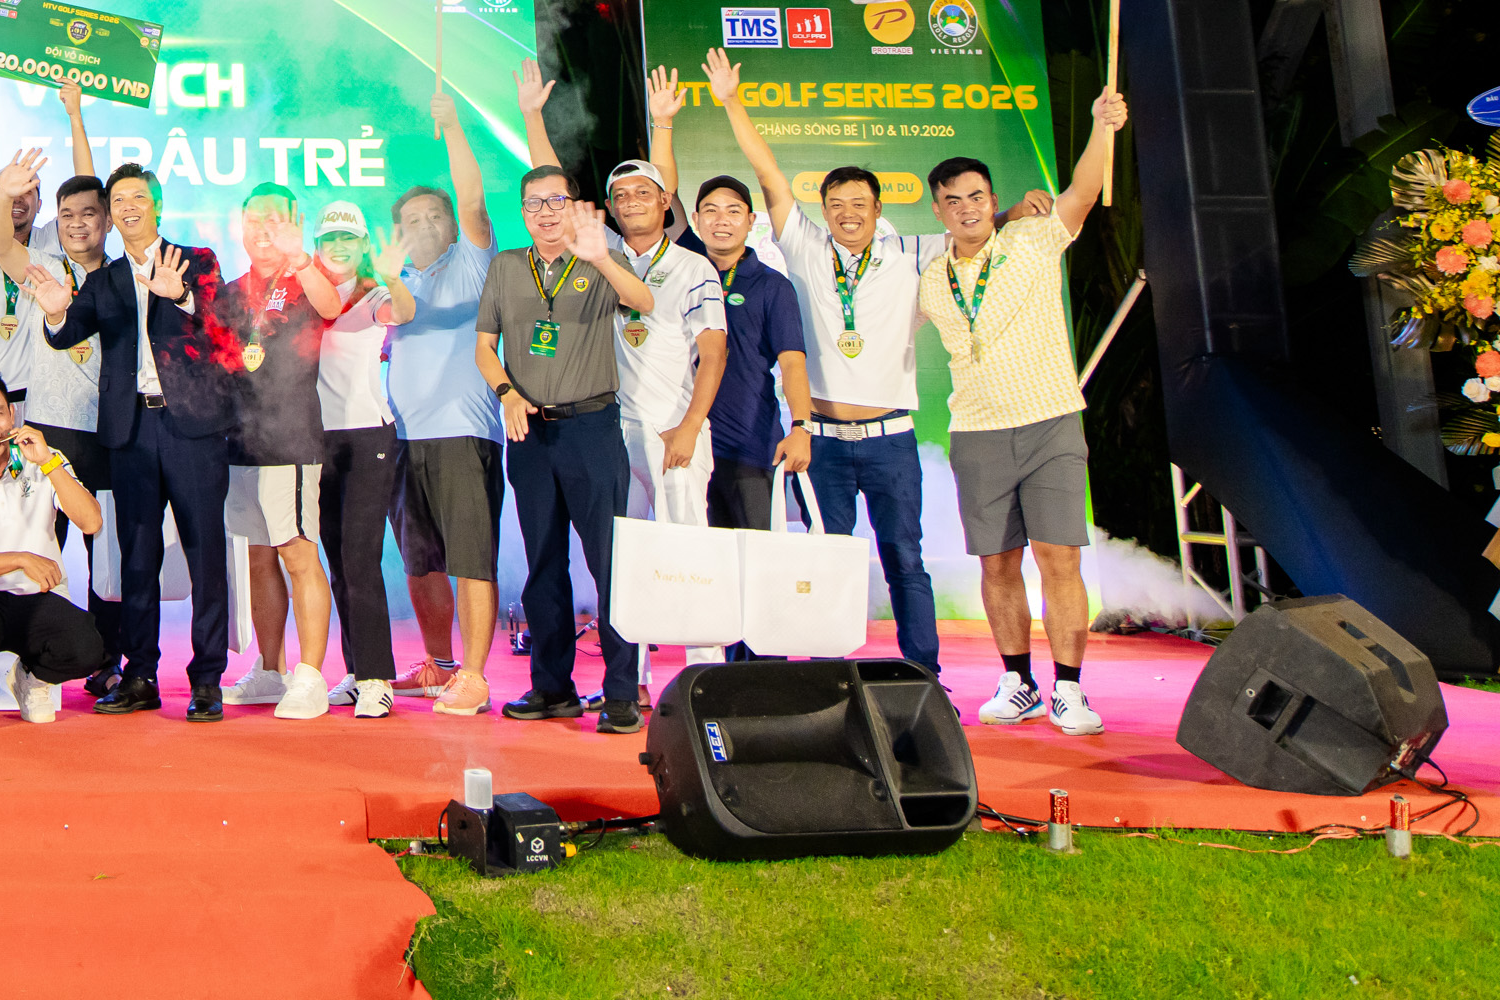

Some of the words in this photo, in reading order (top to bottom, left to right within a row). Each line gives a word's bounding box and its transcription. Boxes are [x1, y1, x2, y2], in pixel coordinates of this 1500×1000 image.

[42, 1, 58, 11] HTV
[58, 4, 76, 14] GOLF
[75, 8, 99, 20] SERIES
[99, 14, 120, 24] 2026
[725, 18, 777, 37] TMS
[932, 23, 948, 40] GOLF
[953, 24, 975, 43] RESORT
[45, 46, 62, 58] ĐỘI
[64, 48, 77, 60] VÔ
[78, 53, 101, 66] ĐỊCH
[111, 76, 150, 99] VNĐ
[155, 62, 246, 116] ỊCH
[737, 82, 817, 107] GOLF
[822, 83, 935, 108] SERIES
[941, 83, 1038, 110] 2026
[755, 122, 801, 137] CHẶNG
[804, 122, 841, 136] SÔNG
[844, 122, 858, 136] BÉ
[871, 124, 884, 136] 10
[887, 125, 897, 136] &
[900, 125, 955, 137] 11.9.2026
[259, 124, 386, 187] TRẺ
[897, 181, 915, 195] DỰ
[320, 211, 357, 225] HONMA
[707, 724, 727, 760] FBT
[526, 854, 548, 862] LCCVN
